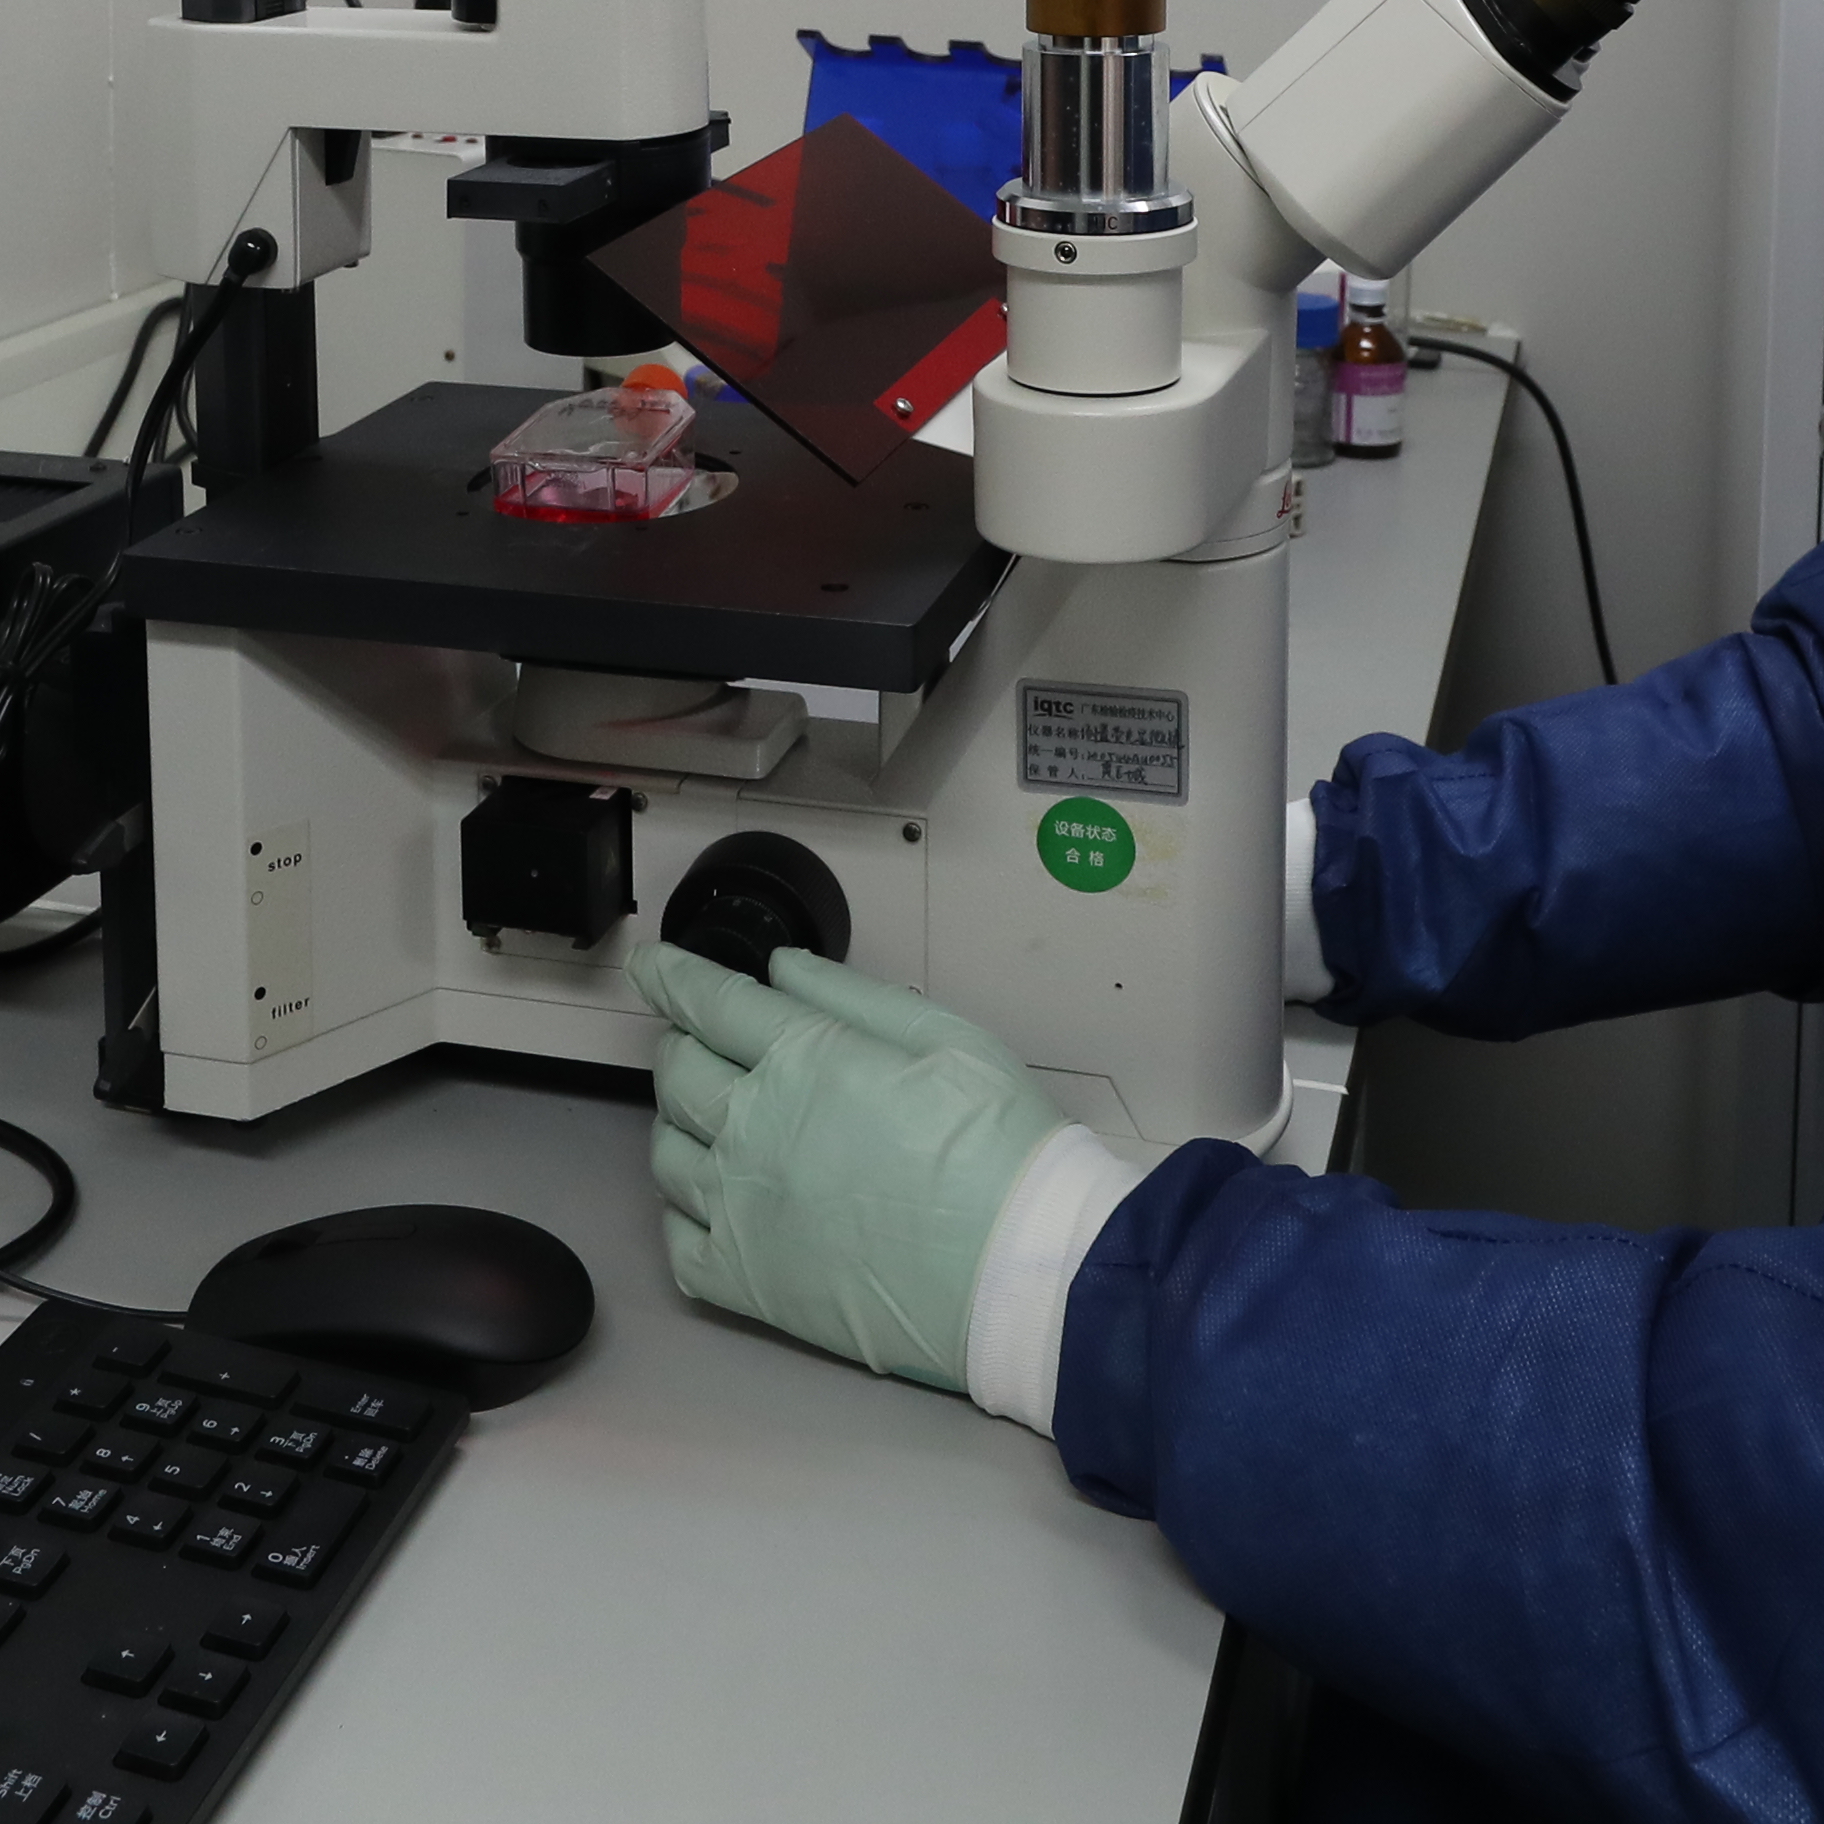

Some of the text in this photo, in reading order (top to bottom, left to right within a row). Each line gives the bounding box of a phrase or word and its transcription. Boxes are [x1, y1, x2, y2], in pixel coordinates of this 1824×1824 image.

[1033, 695, 1075, 717] iqtc
[1054, 819, 1118, 843] 设备状态
[267, 852, 303, 873] stop
[1065, 847, 1105, 867] 合格
[271, 996, 311, 1020] filter
[135, 1402, 151, 1412] 9
[159, 1398, 183, 1419] PgUp
[202, 1418, 218, 1429] 6
[269, 1435, 286, 1446] 3
[295, 1431, 318, 1453] PgDn
[96, 1447, 112, 1458] 8
[165, 1464, 181, 1475] 5
[2, 1475, 26, 1494] Num
[12, 1476, 35, 1497] Lock
[234, 1481, 252, 1492] 2
[51, 1496, 67, 1507] 7
[80, 1488, 108, 1514] Home
[126, 1514, 141, 1525] 4
[222, 1534, 243, 1552] End
[12, 1547, 41, 1575] PgDn
[267, 1552, 284, 1563] 0
[295, 1544, 321, 1571] Insert
[14, 1772, 44, 1803] 上档
[76, 1790, 107, 1822] 控制
[98, 1794, 122, 1820] Ctrl
